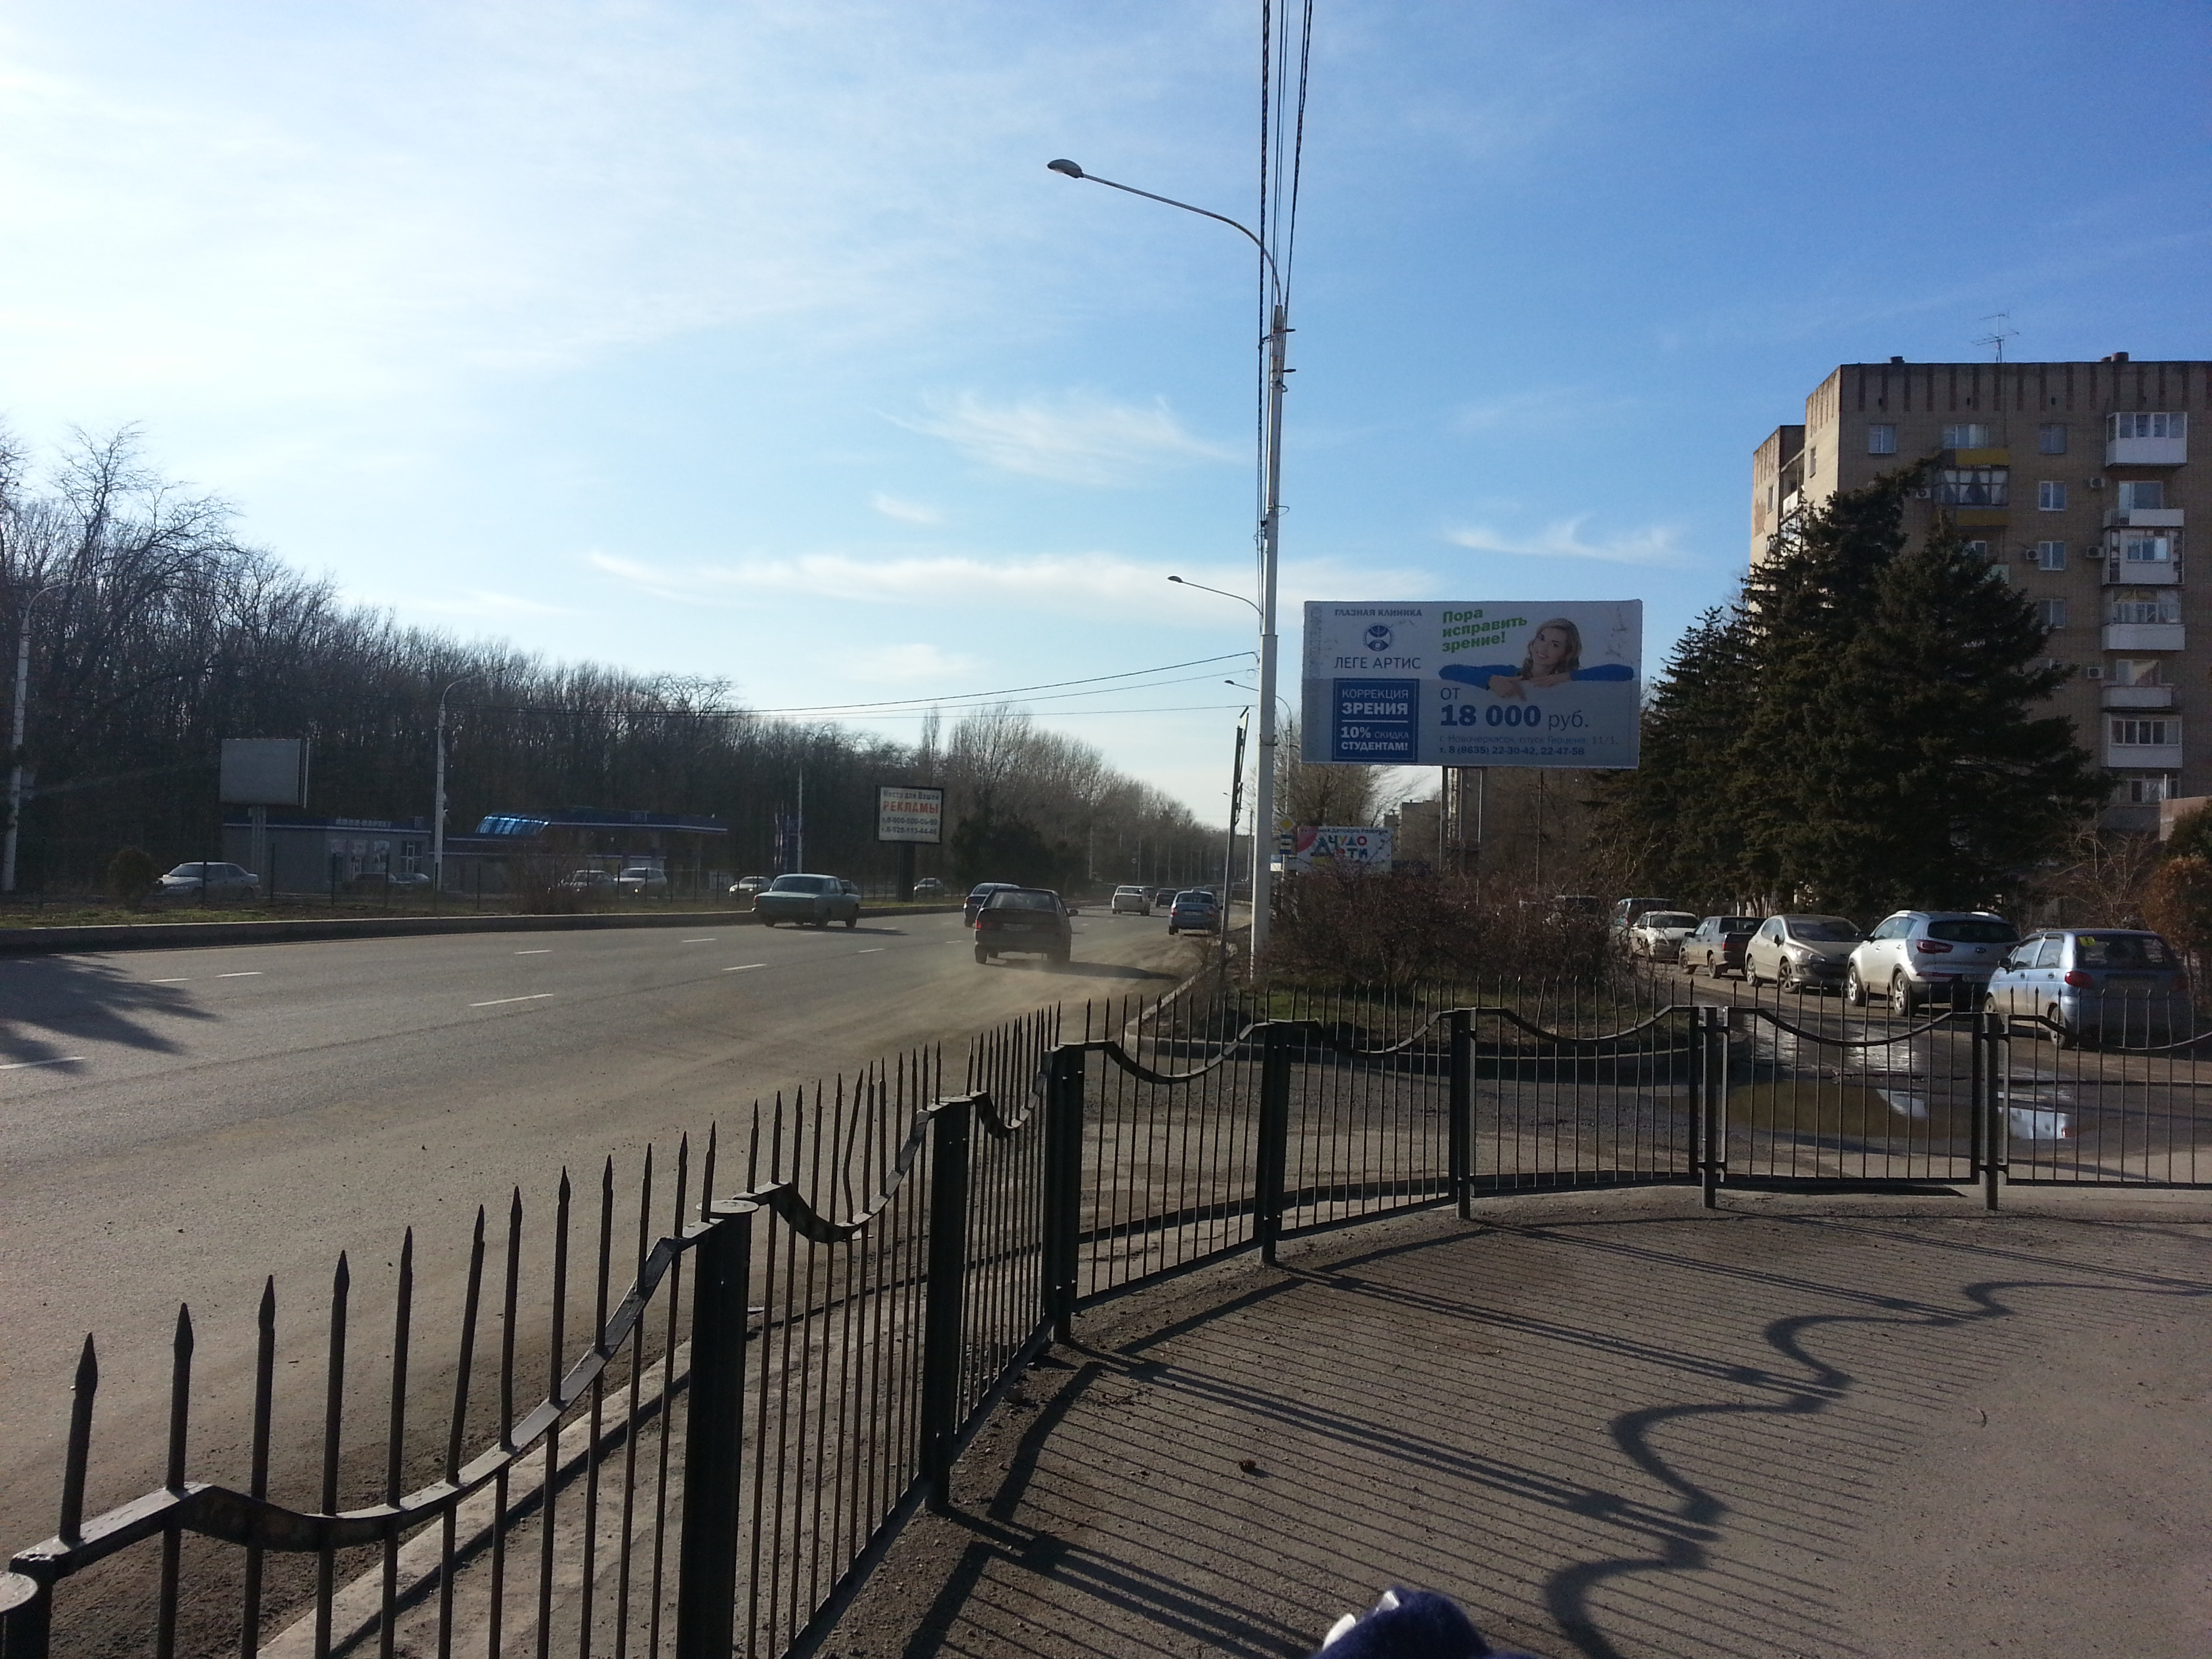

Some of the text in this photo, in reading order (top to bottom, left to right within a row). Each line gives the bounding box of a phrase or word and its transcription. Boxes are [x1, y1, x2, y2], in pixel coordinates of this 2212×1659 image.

[1334, 609, 1422, 617] ГЛАЗНАЯ КЛИНИКА
[1443, 609, 1483, 623] Пора
[1442, 617, 1528, 638] исправить
[1442, 631, 1506, 653] зрение!
[1334, 657, 1421, 670] ЛЕГЕ АРТИС
[1341, 689, 1409, 700] КОРРЕКЦИЯ
[1341, 702, 1408, 715] ЗРЕНИЯ
[1440, 704, 1589, 731] 18 000 руб.
[1340, 726, 1410, 740] 10% СКИДКА
[1340, 741, 1408, 752] СТУДЕНТАМ!
[883, 800, 939, 813] РЕКЛАМЫ
